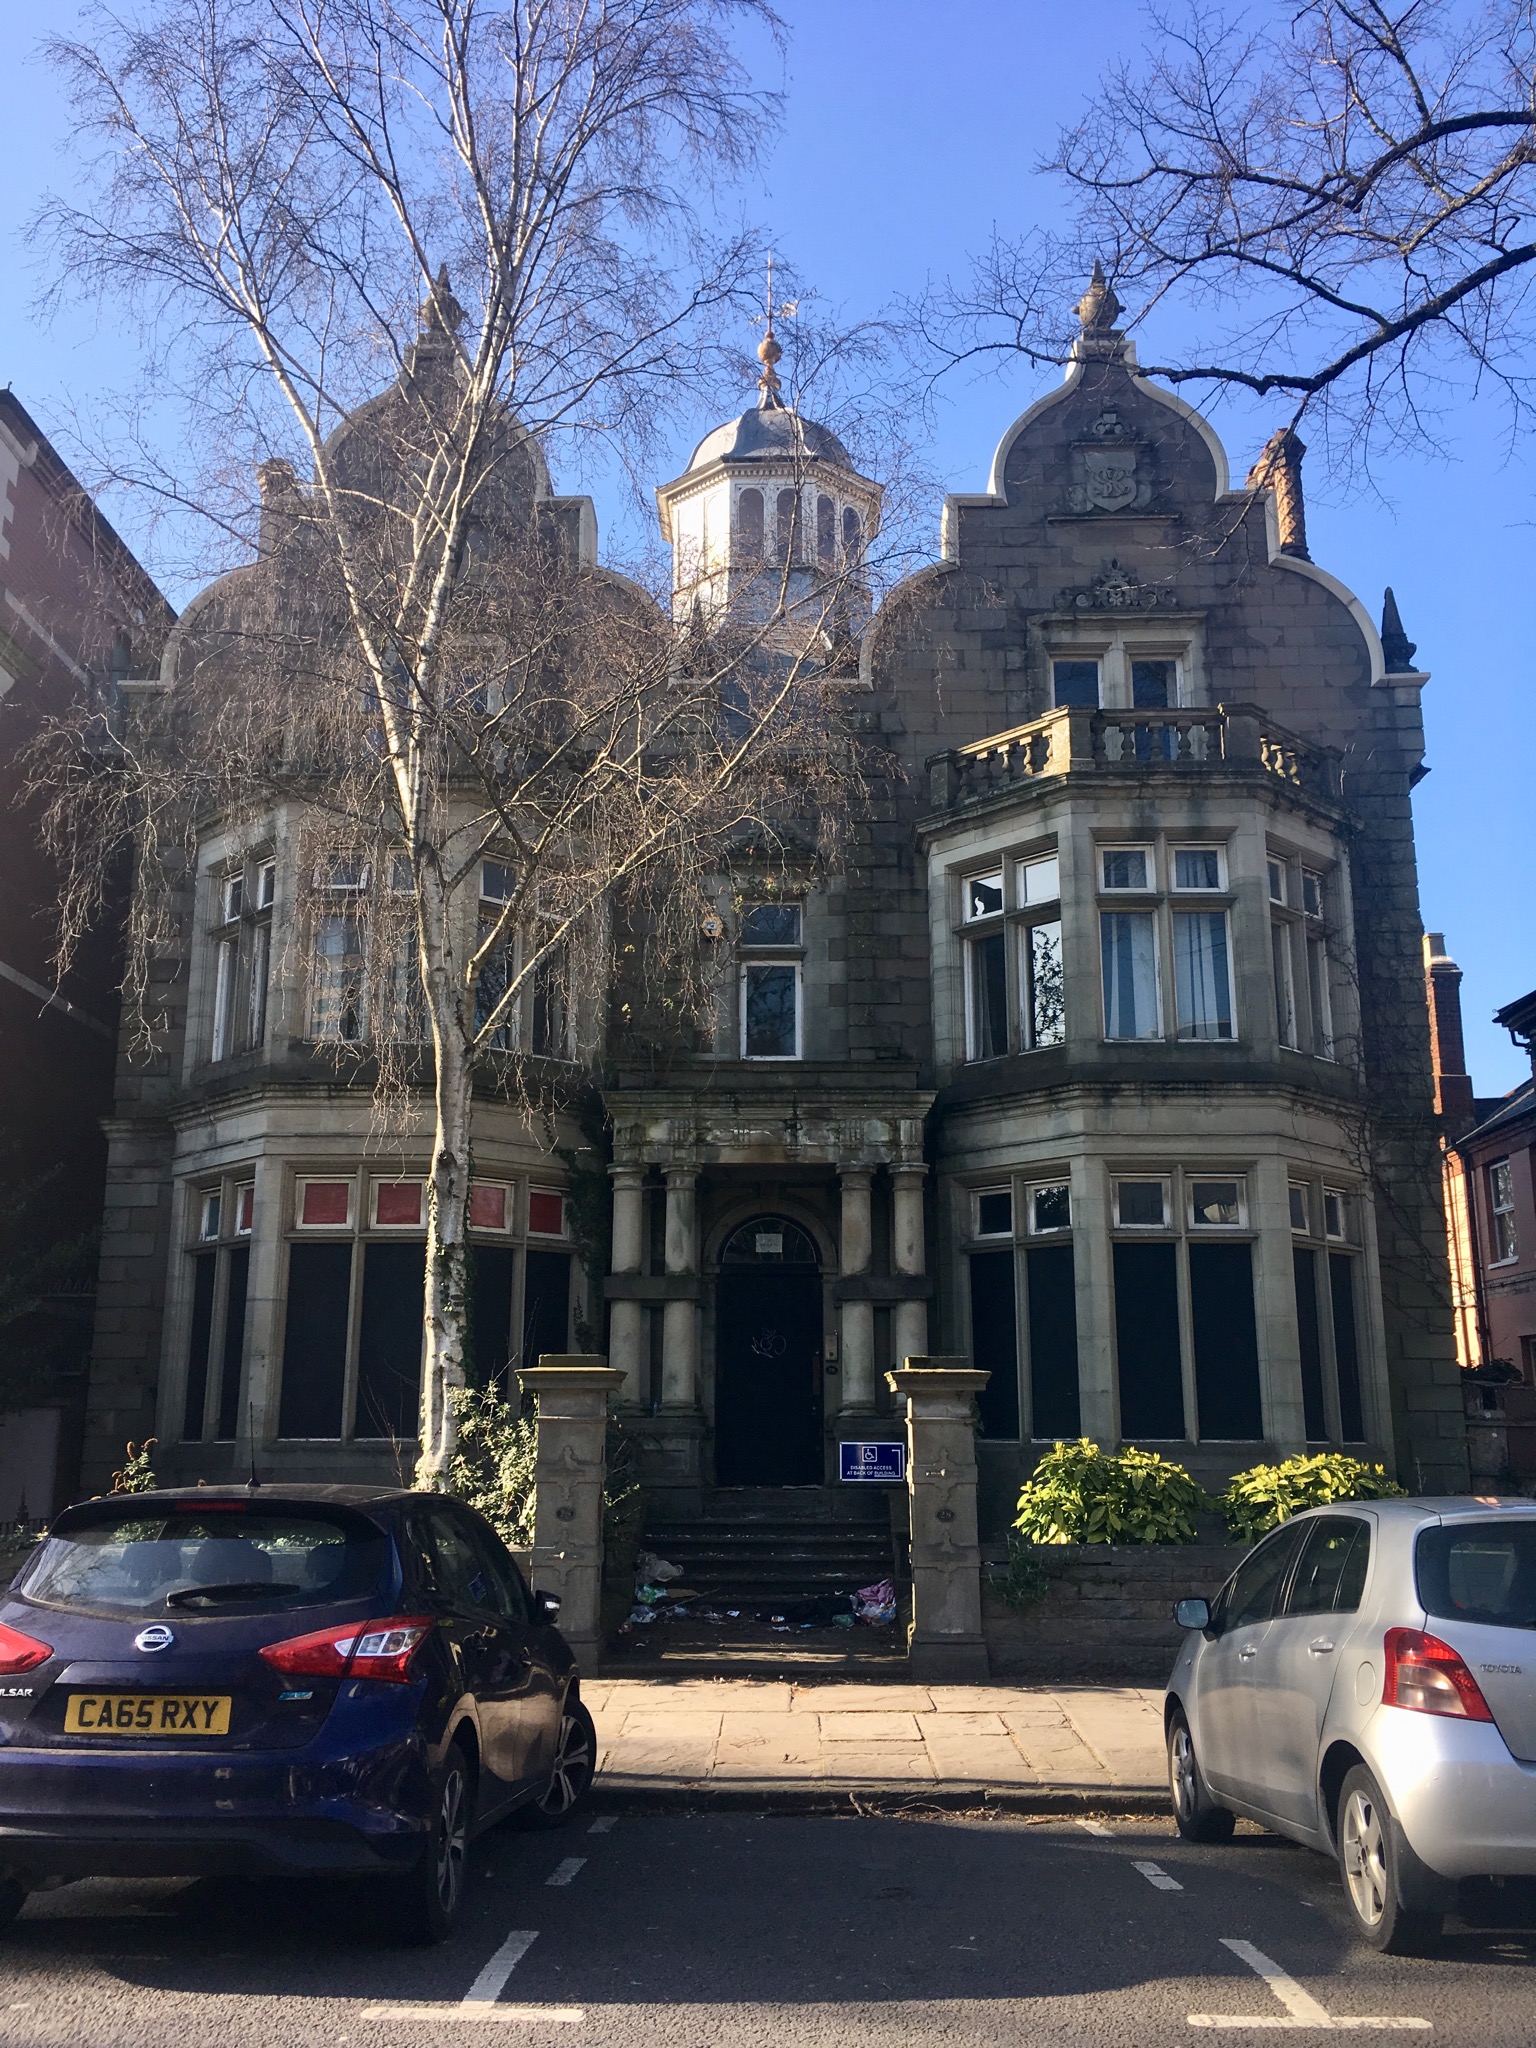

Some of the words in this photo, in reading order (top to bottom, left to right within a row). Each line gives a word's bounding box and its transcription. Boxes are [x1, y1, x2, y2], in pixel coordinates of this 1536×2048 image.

[1480, 1664, 1522, 1674] TOYOTA
[78, 1699, 154, 1728] CA65
[160, 1700, 219, 1729] RXY
